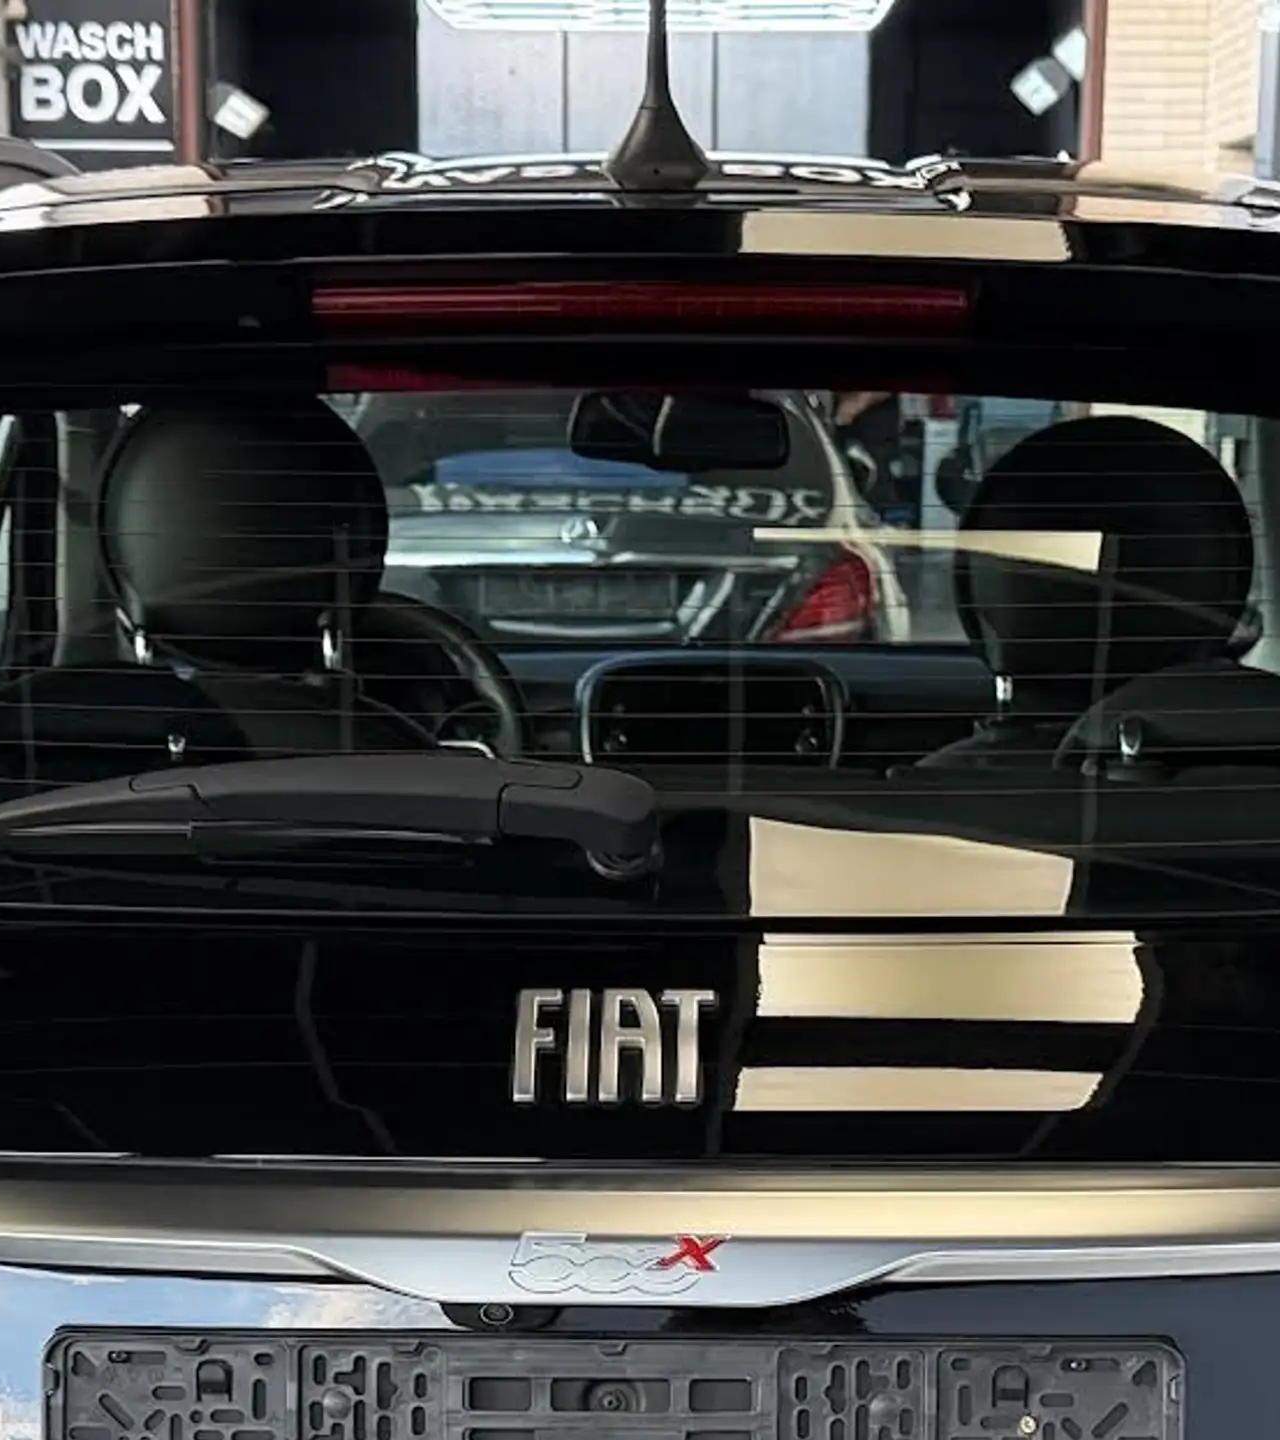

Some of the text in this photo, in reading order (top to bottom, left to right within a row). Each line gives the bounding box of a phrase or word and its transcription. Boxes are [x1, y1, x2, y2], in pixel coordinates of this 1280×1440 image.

[16, 22, 166, 61] WASCH
[21, 63, 167, 124] BOX
[512, 987, 718, 1105] FIAT
